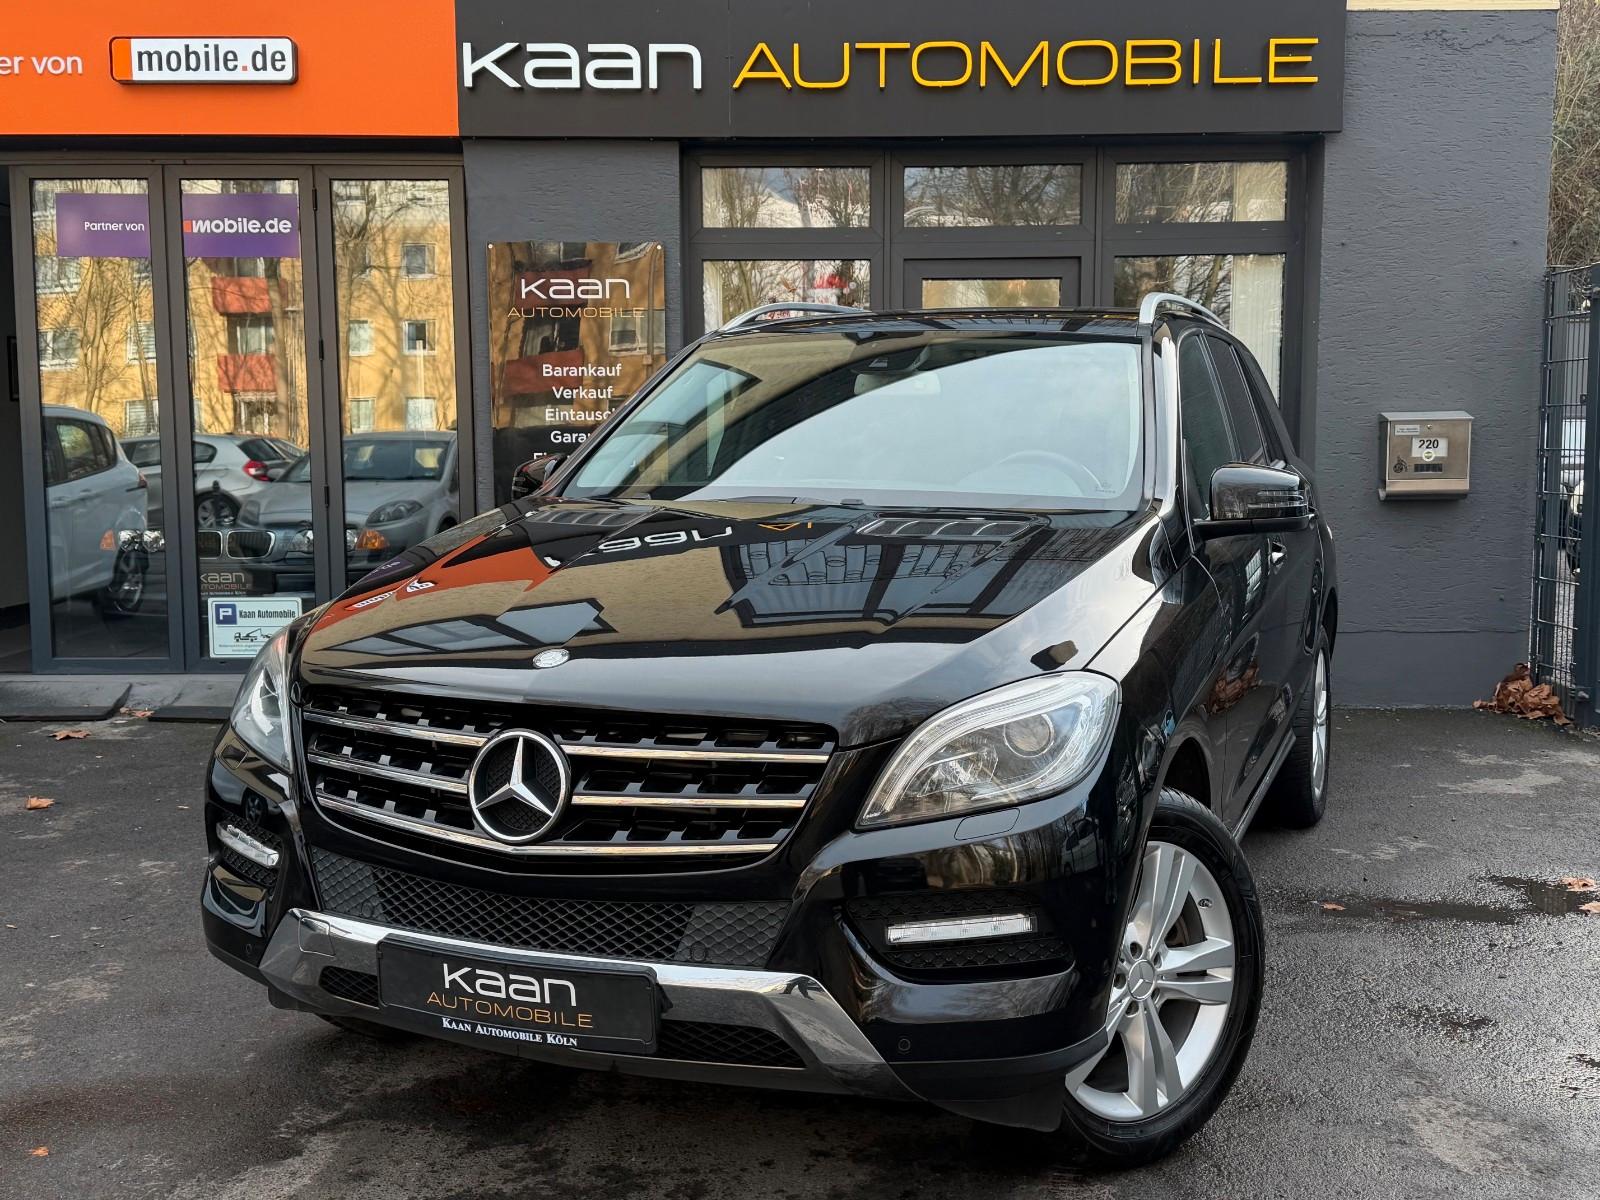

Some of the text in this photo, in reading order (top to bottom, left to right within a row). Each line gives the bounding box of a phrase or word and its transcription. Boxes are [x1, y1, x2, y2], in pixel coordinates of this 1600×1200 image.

[136, 43, 287, 73] mobile.de
[732, 37, 1320, 90] AUTOMOBILE
[31, 55, 83, 75] von
[84, 221, 145, 231] Partner von
[192, 217, 292, 234] mobile.de
[507, 306, 646, 318] AUTOMOBILE
[542, 363, 622, 377] Barankauf
[552, 386, 613, 399] Verkauf
[545, 408, 616, 421] Eintausc
[550, 430, 591, 443] Gara
[1418, 439, 1439, 449] 220
[219, 608, 233, 621] P
[239, 609, 296, 619] Kaan Automobile
[427, 991, 593, 1029] AUTOMOBILE
